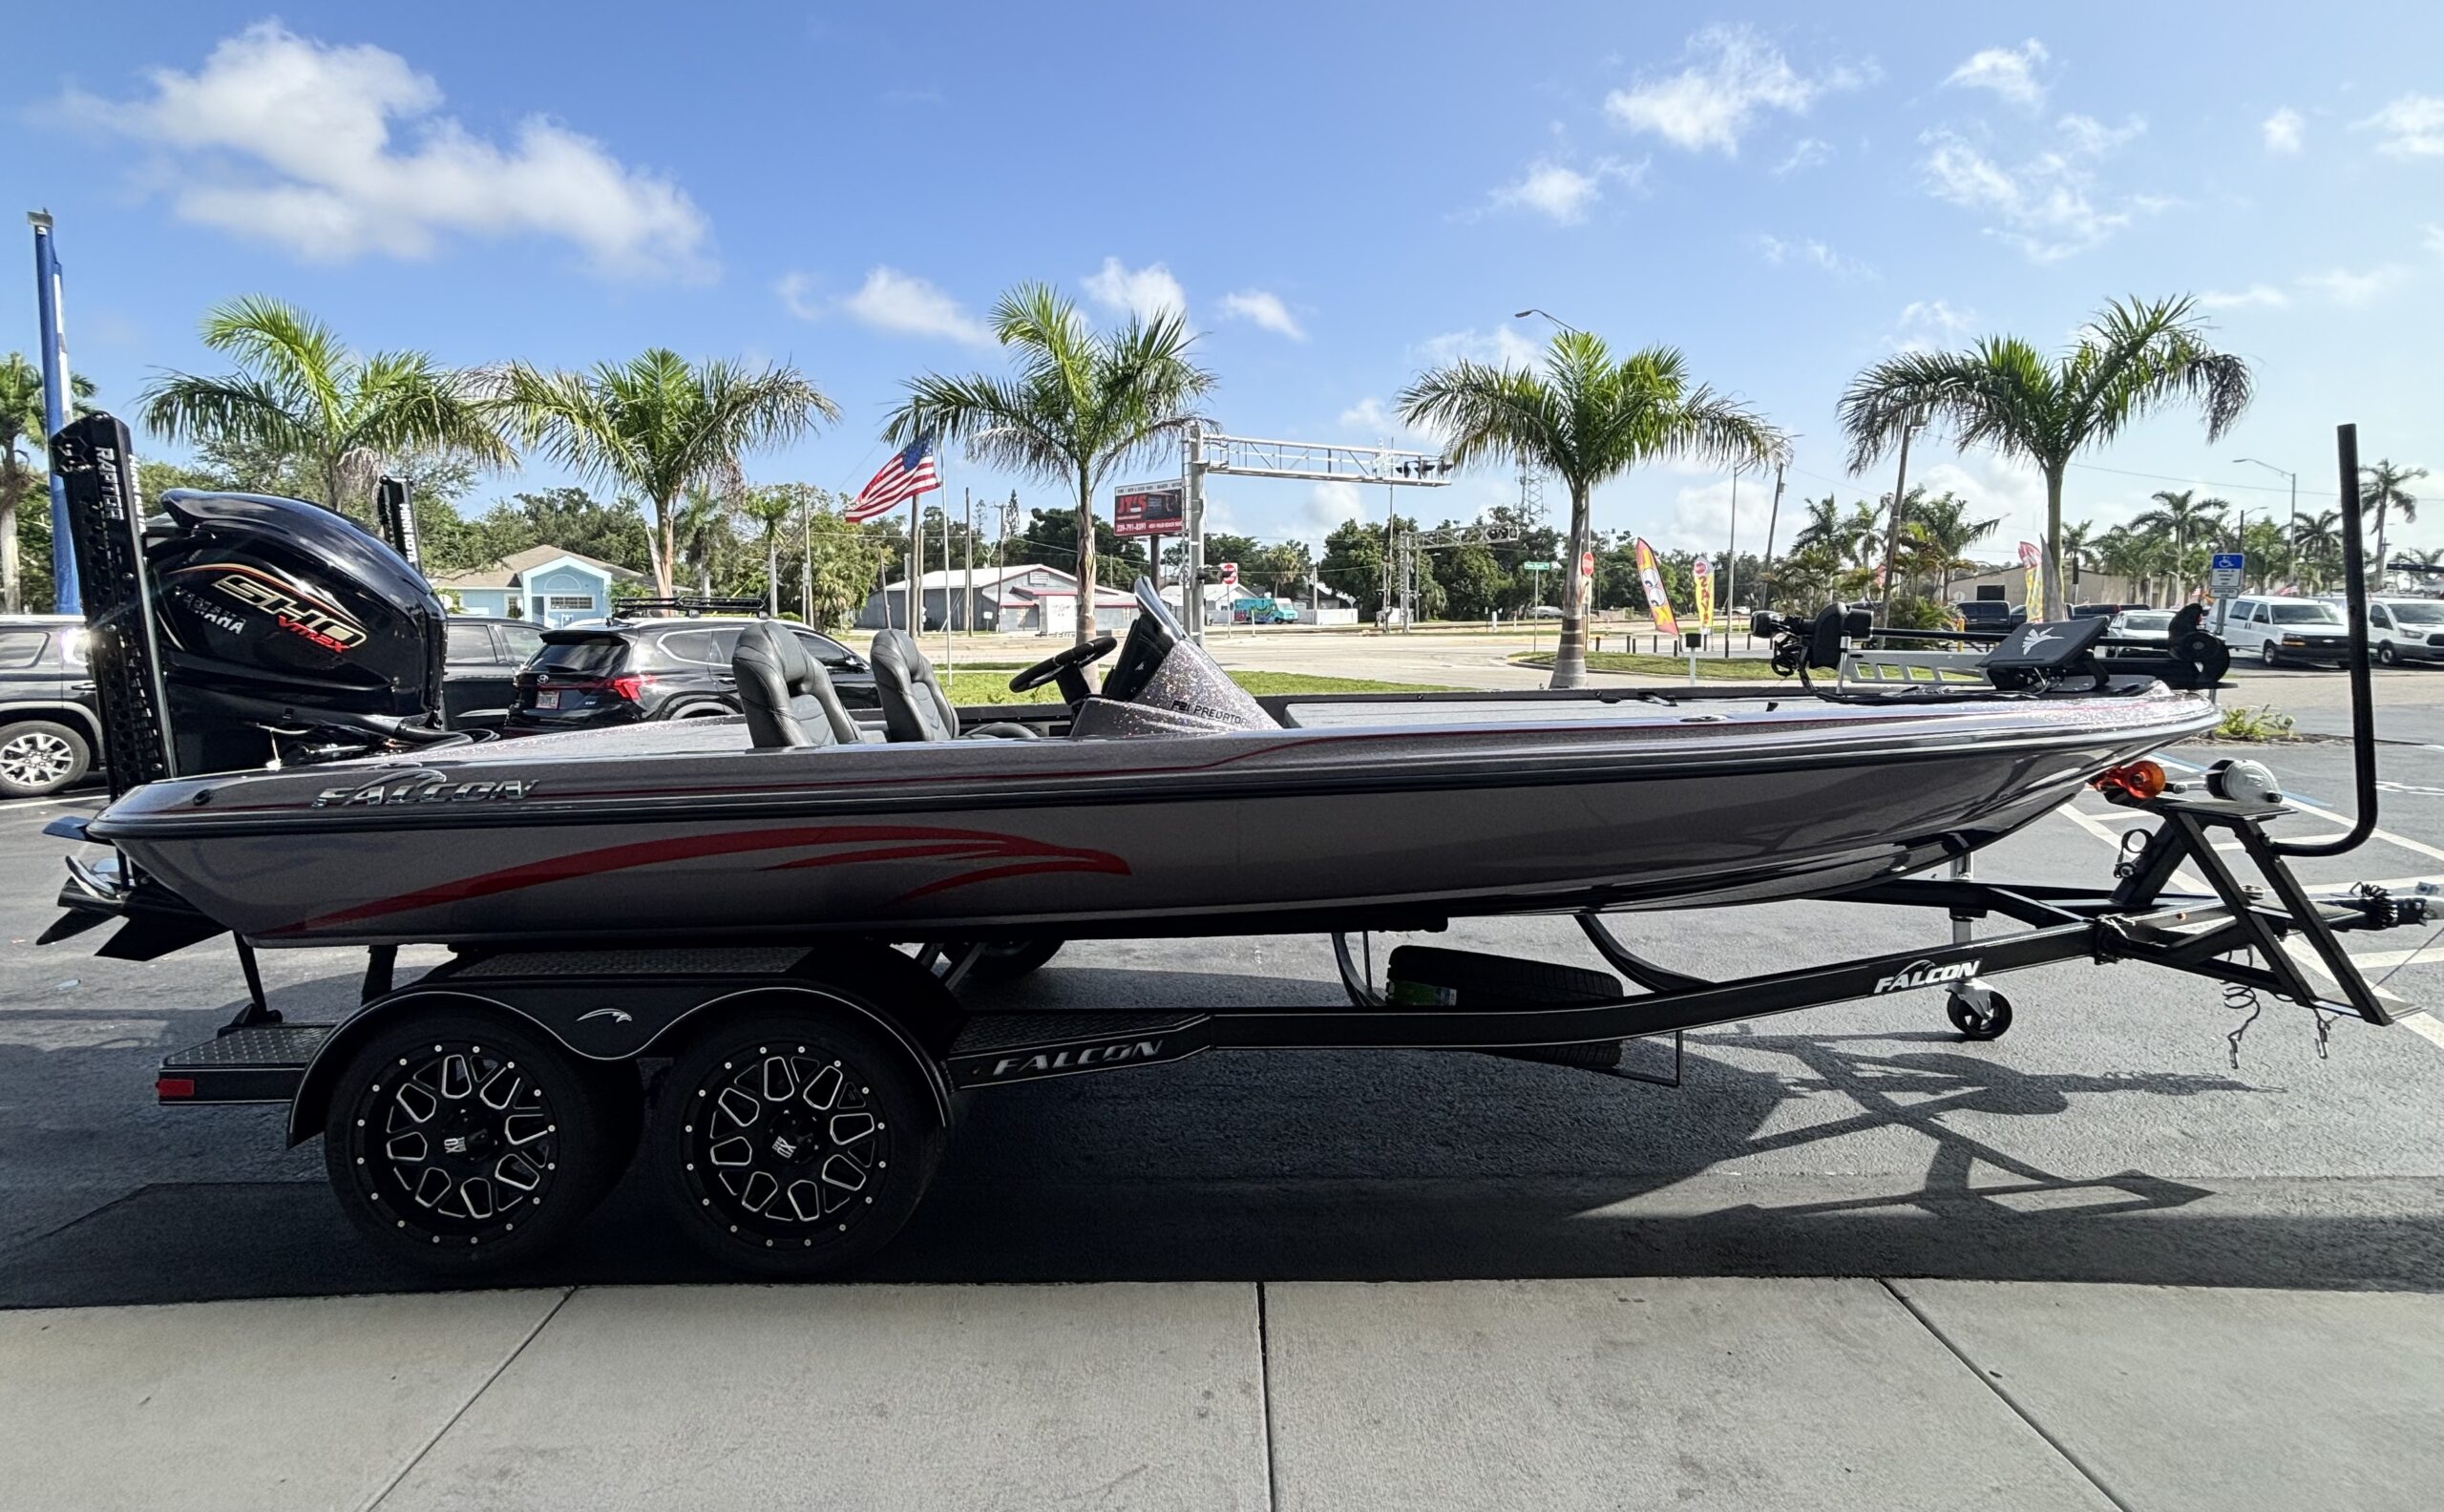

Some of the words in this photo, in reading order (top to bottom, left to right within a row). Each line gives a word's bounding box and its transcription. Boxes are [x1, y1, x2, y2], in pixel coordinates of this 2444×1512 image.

[399, 503, 414, 533] MINN
[404, 534, 418, 563] KOTA
[211, 575, 368, 648] SHO
[311, 778, 540, 808] FALCON
[1872, 959, 1982, 994] FALCON
[992, 1040, 1163, 1076] FALCON
